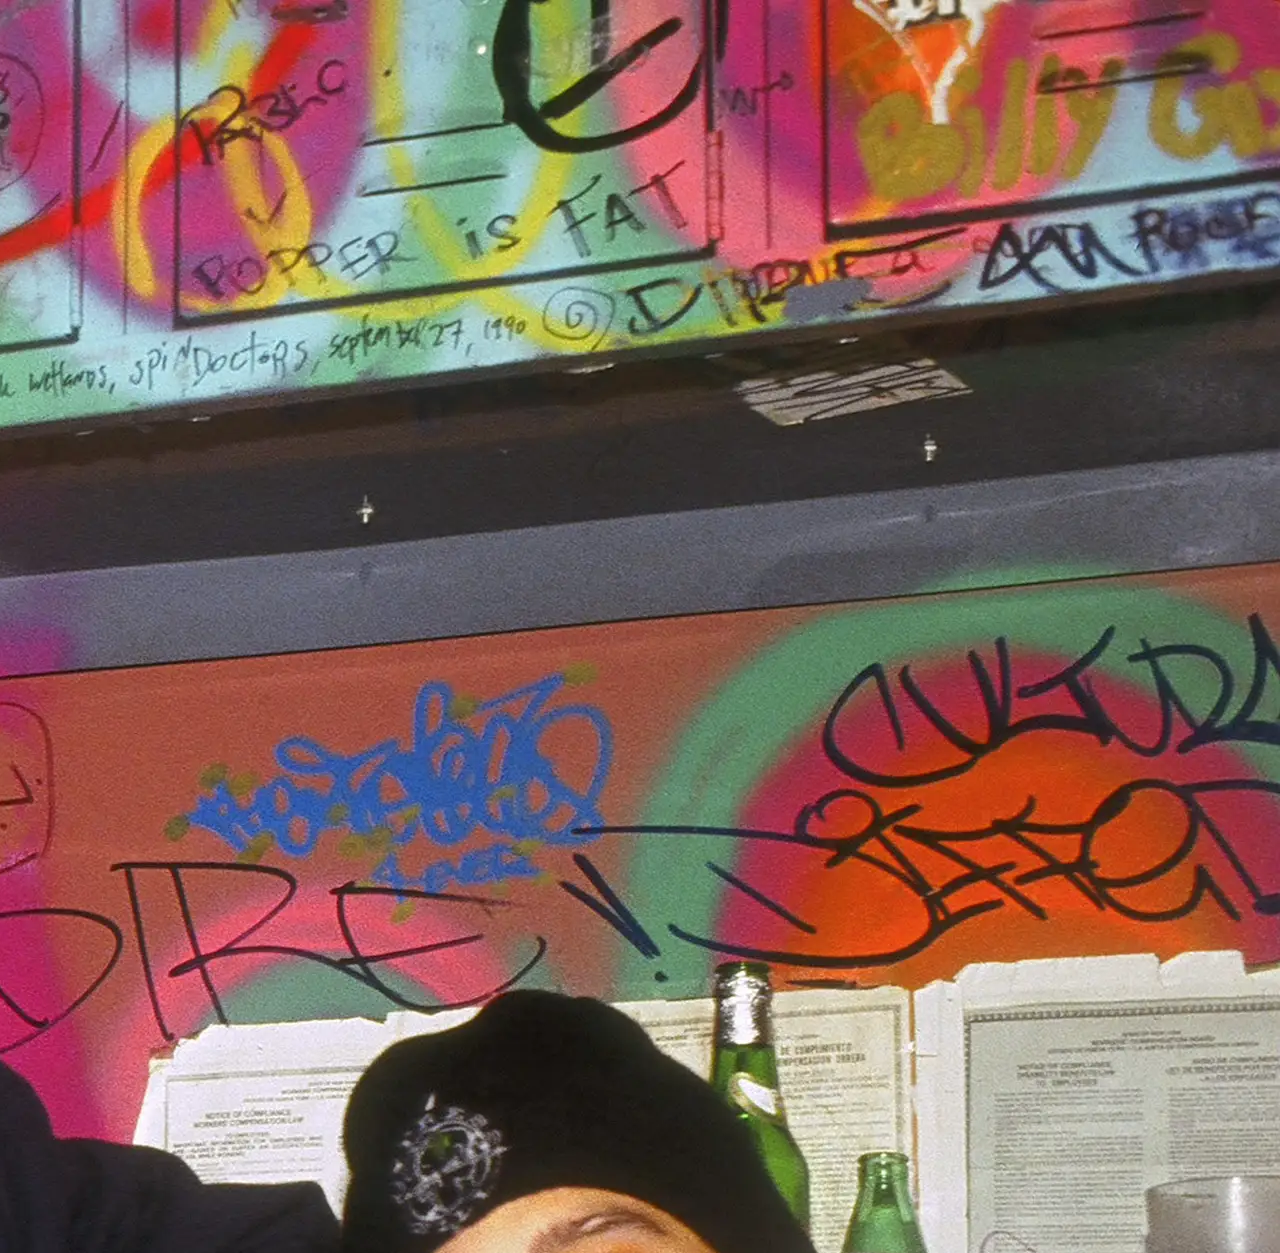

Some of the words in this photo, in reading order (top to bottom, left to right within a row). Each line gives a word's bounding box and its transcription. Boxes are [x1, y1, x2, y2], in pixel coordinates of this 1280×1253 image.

[191, 230, 418, 299] POPPER
[545, 158, 692, 258] FAT
[483, 315, 527, 343] 1990
